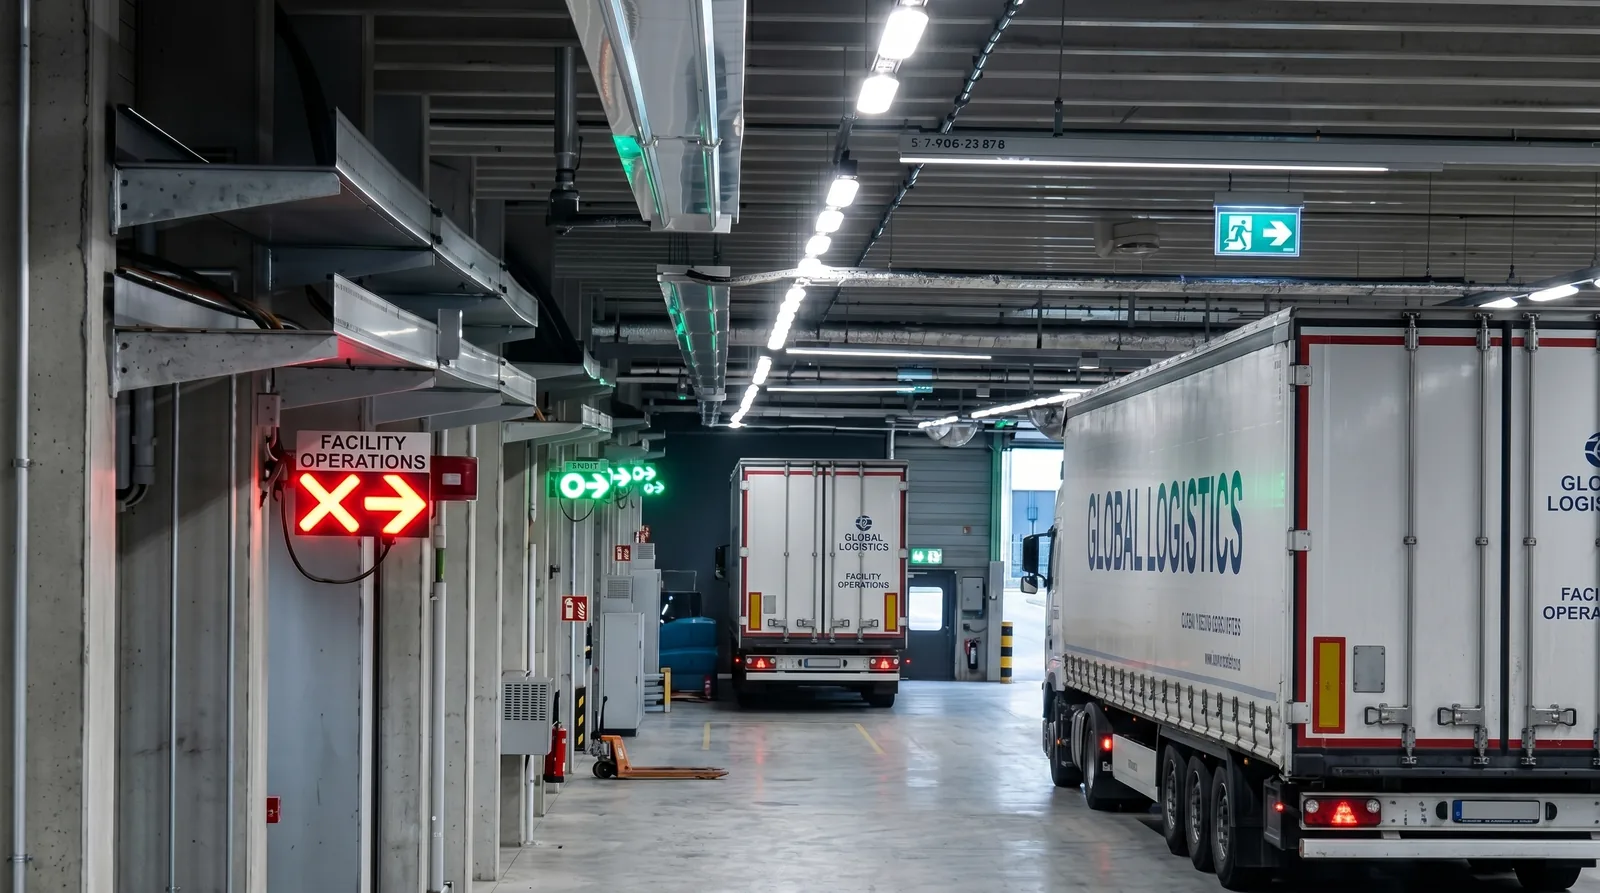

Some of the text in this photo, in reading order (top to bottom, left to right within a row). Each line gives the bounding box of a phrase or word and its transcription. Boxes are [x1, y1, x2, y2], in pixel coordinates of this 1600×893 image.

[982, 139, 1005, 149] 878
[321, 435, 407, 451] FACILITY
[300, 453, 426, 470] OPERATIONS
[1087, 470, 1243, 575] GLOBAL LOGISTICS
[844, 533, 883, 541] GLOBAL
[839, 542, 889, 551] LOGISTICS
